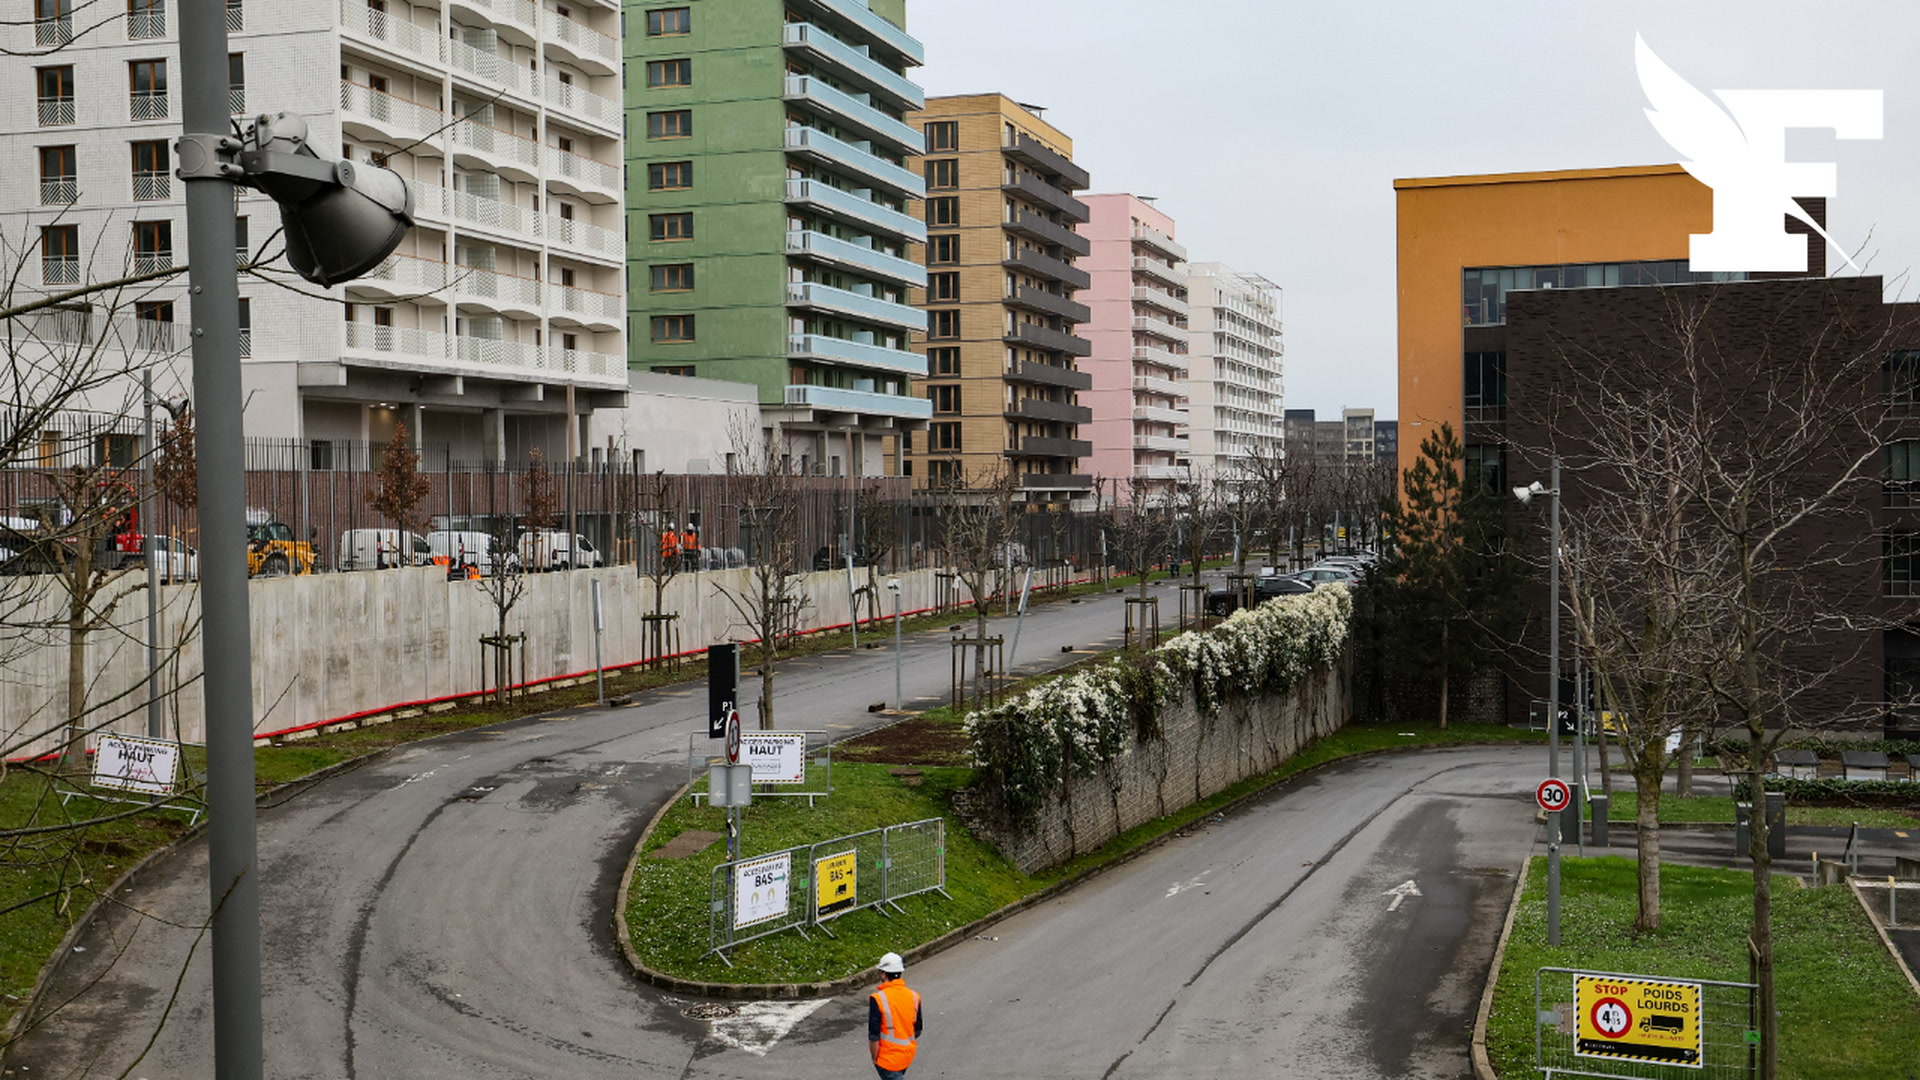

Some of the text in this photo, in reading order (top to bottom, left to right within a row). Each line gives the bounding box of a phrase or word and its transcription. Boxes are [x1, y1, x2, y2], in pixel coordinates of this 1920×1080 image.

[722, 701, 733, 711] P1
[118, 749, 156, 763] HAUT
[749, 745, 784, 755] HAUT
[1543, 788, 1564, 803] 30
[755, 872, 773, 887] BAS
[830, 869, 844, 882] BAS
[1594, 984, 1628, 995] STOP
[1643, 988, 1682, 1001] POIDS
[1637, 999, 1689, 1013] LOURDS
